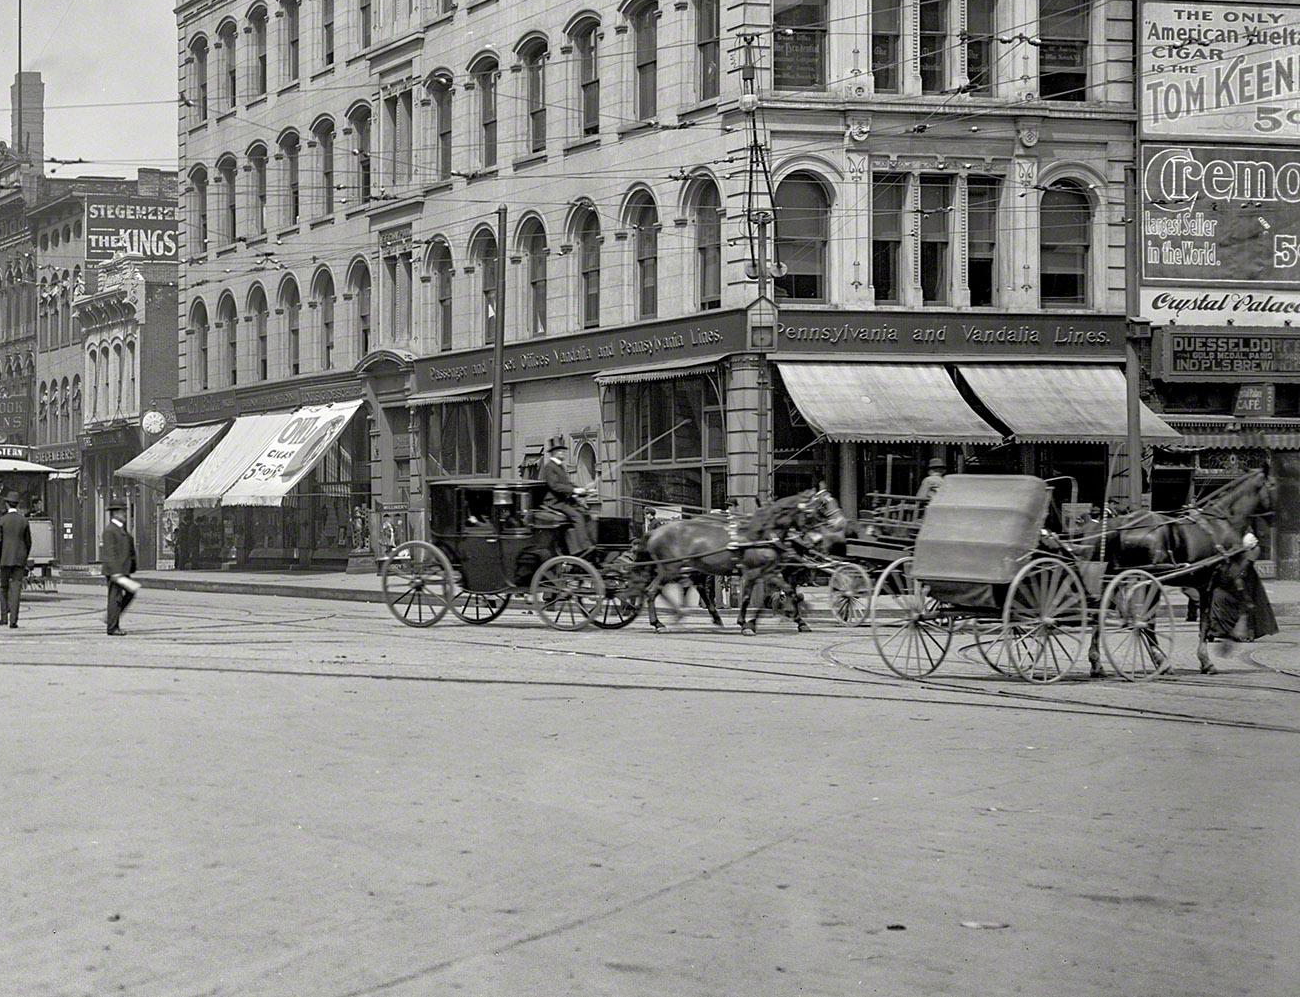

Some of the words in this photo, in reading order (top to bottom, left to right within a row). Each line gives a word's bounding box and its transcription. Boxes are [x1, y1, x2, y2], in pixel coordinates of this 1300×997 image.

[1173, 9, 1213, 21] THE
[1223, 12, 1284, 24] ONLY
[1243, 25, 1300, 46] Vuelt
[1152, 45, 1224, 60] CIGAR
[1151, 64, 1165, 74] IS
[1171, 65, 1198, 74] THE
[1146, 76, 1205, 125] TOM
[1215, 54, 1300, 110] KEEN
[1144, 148, 1300, 213] Cremo
[1183, 212, 1218, 237] Seller
[88, 235, 118, 247] THE
[119, 228, 179, 256] KINGS
[1147, 240, 1160, 264] in
[1162, 240, 1182, 265] the
[1274, 234, 1300, 268] 5
[1151, 292, 1229, 317] Crystal
[598, 341, 615, 358] and
[620, 331, 685, 357] Pennsylvania
[690, 327, 724, 346] Lines.
[777, 322, 899, 343] Pennsylvania
[912, 325, 948, 342] and
[962, 324, 1040, 344] Vandalia
[1054, 326, 1111, 344] Lines.
